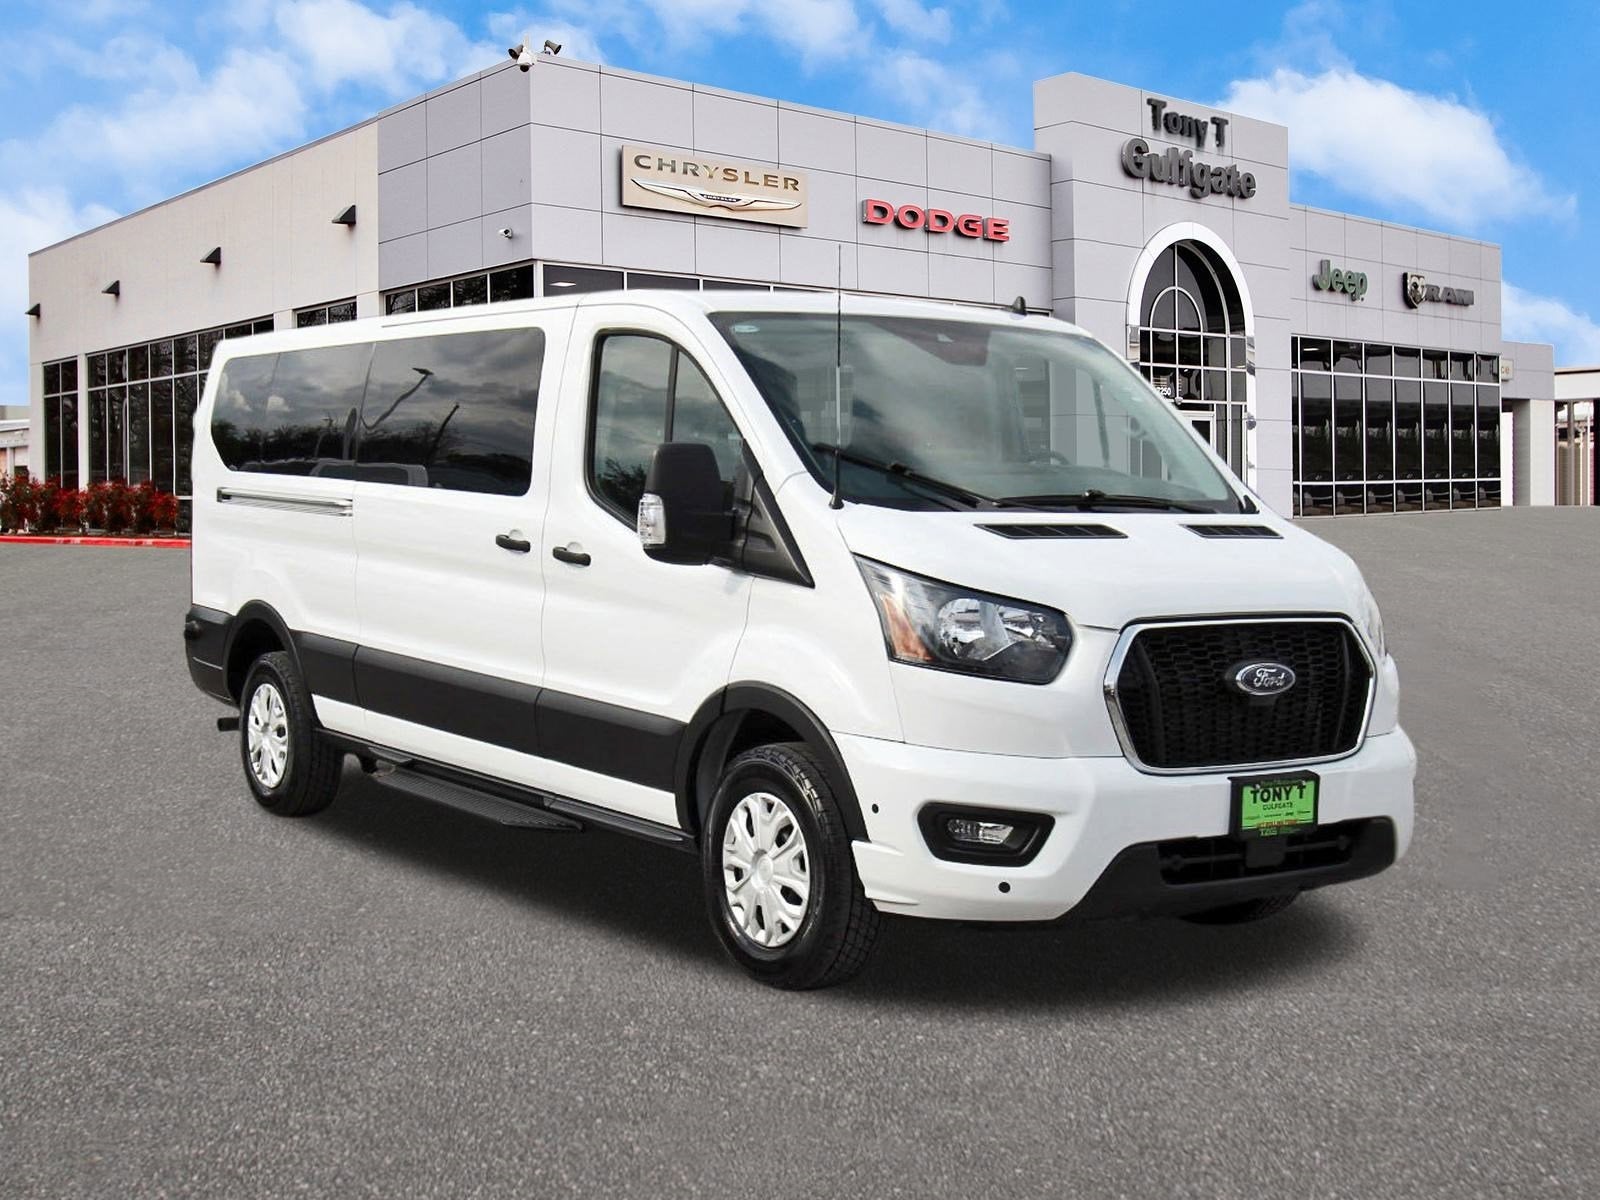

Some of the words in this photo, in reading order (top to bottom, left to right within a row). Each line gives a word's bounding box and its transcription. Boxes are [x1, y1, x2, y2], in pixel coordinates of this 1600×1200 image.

[1147, 98, 1208, 147] Tony
[1211, 117, 1229, 147] T
[634, 155, 800, 192] CHRYSLER
[1121, 138, 1256, 199] Gulfgate
[862, 199, 1009, 242] DODGE
[1312, 259, 1368, 302] Jeep
[1425, 284, 1474, 306] RAM
[1253, 668, 1285, 688] Ford
[1250, 785, 1293, 804] TONY
[1296, 784, 1306, 799] T
